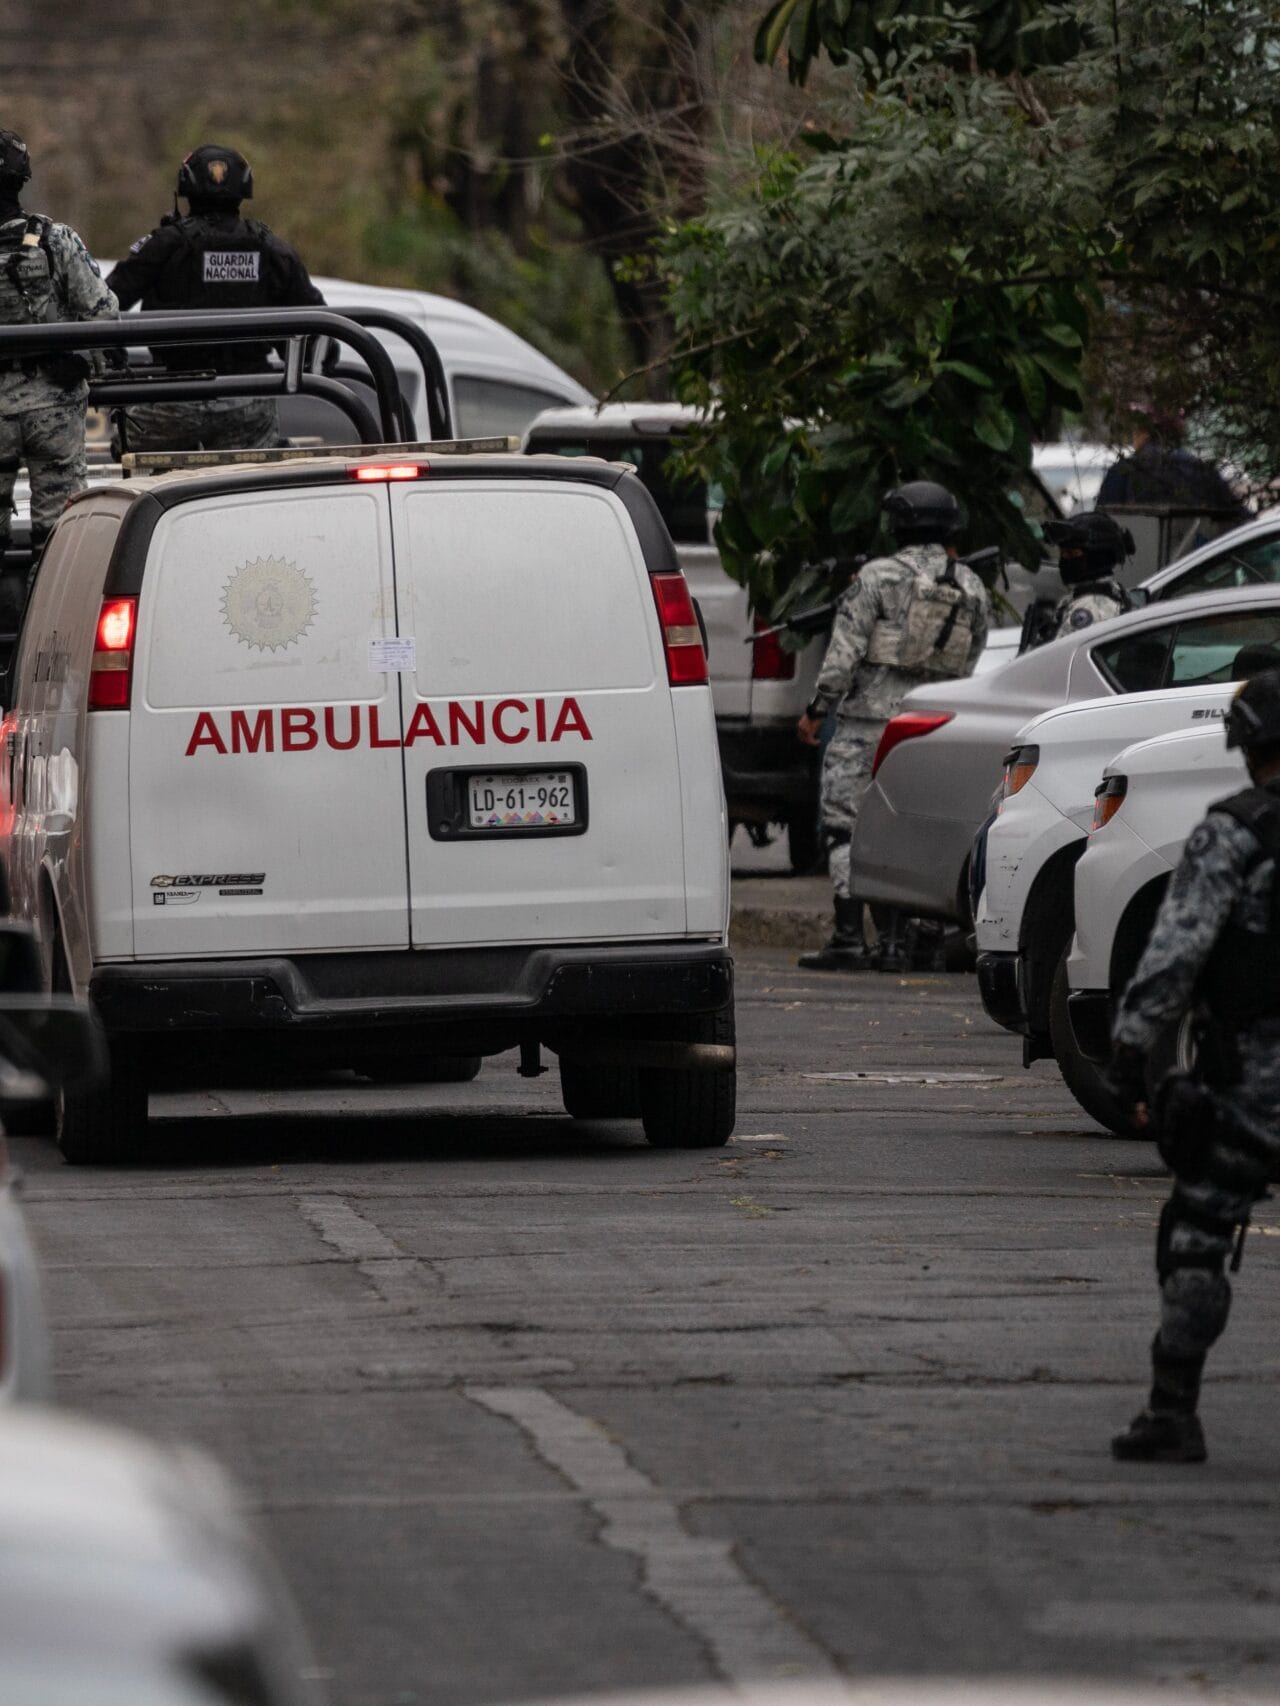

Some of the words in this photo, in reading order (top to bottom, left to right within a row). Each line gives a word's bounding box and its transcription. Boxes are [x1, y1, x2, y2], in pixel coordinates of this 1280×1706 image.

[209, 254, 255, 266] GUARDIA
[206, 267, 257, 279] NACIONAL
[184, 697, 593, 756] AMBULANCIA
[473, 787, 570, 812] LD-61-962
[175, 873, 266, 886] EXPRESS
